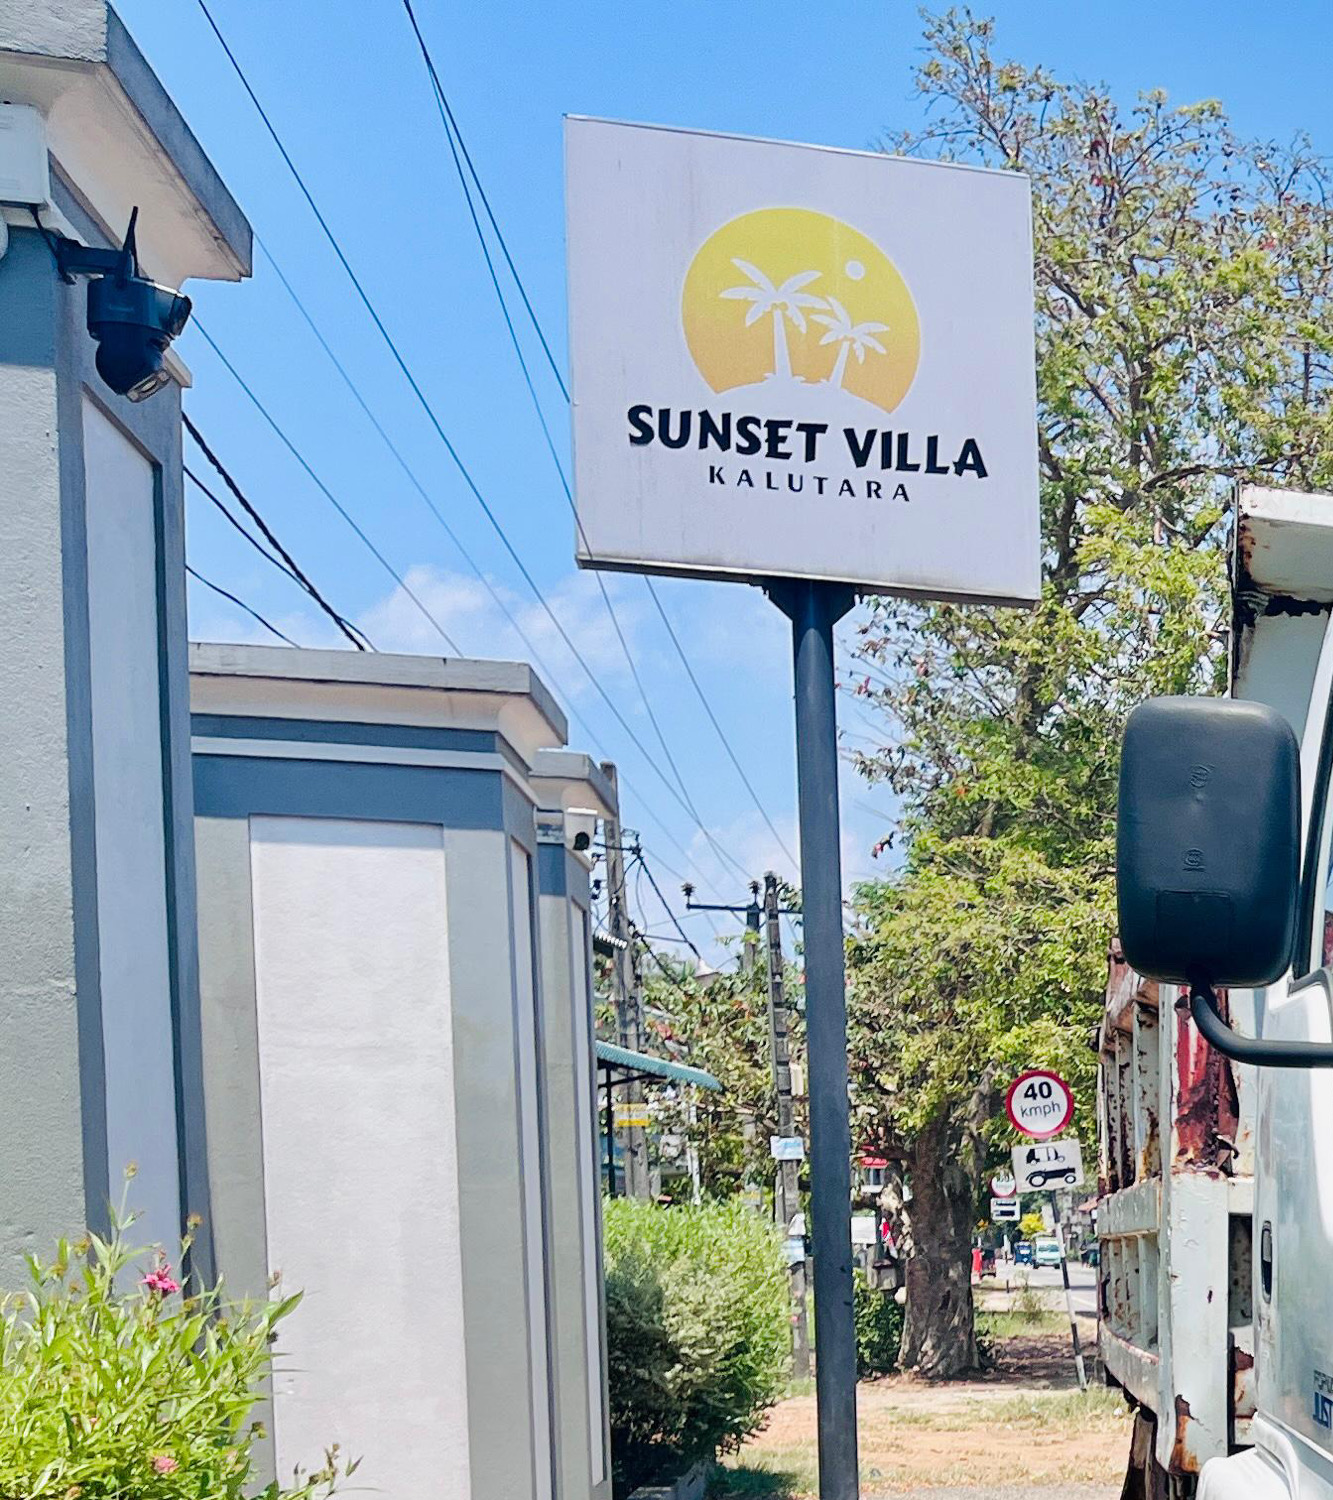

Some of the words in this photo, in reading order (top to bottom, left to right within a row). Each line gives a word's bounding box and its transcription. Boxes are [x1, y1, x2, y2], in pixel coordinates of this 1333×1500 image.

[627, 404, 827, 463] SUNSET
[843, 427, 989, 479] VILLA
[708, 465, 911, 503] KALUTARA
[1024, 1081, 1052, 1099] 40
[1020, 1101, 1061, 1118] kmph
